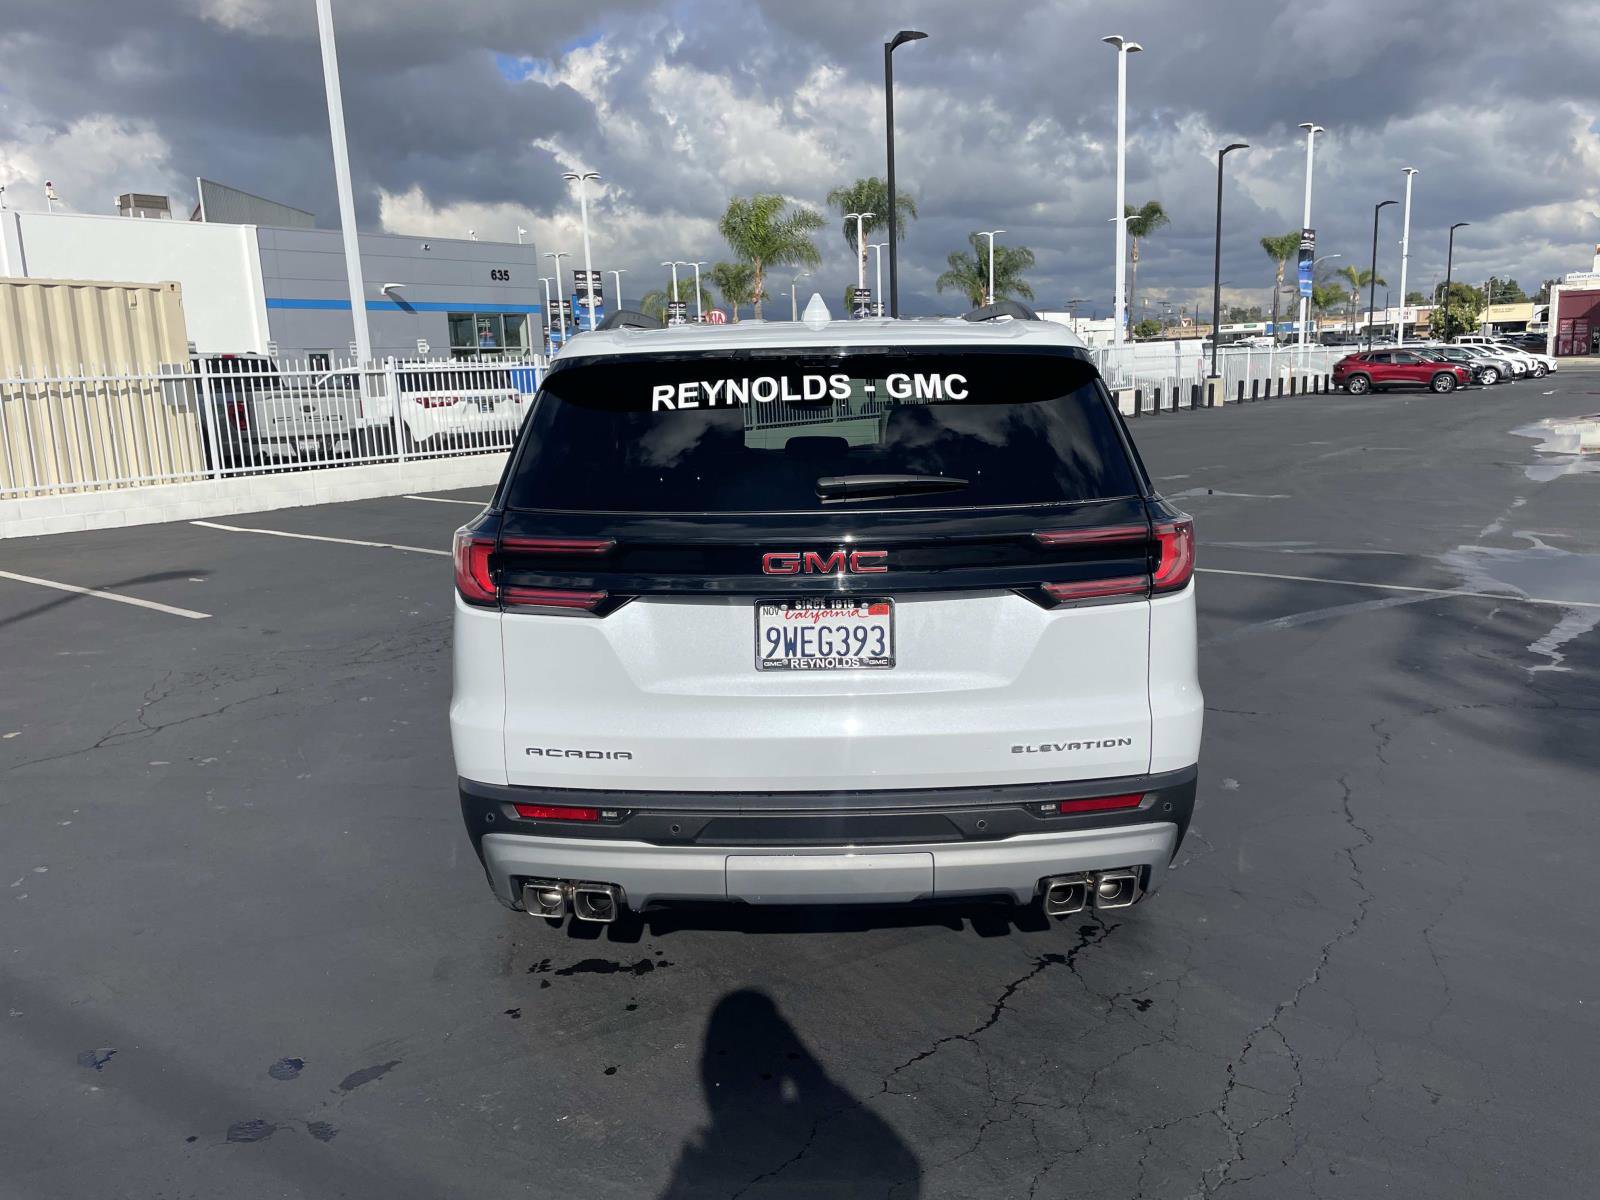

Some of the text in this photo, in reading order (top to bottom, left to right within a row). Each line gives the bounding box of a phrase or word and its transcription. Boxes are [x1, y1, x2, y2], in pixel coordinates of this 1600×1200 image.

[491, 270, 509, 280] 635
[652, 374, 851, 412] REYNOLDS
[886, 373, 968, 400] GMC
[762, 551, 888, 574] GMC
[763, 607, 779, 616] NOV
[795, 600, 825, 609] SINCE
[785, 609, 868, 624] California
[766, 626, 885, 658] 9WEG393
[791, 658, 860, 668] REYNOLDS
[1011, 738, 1132, 753] ELEVATION
[526, 747, 632, 760] ACADIA
